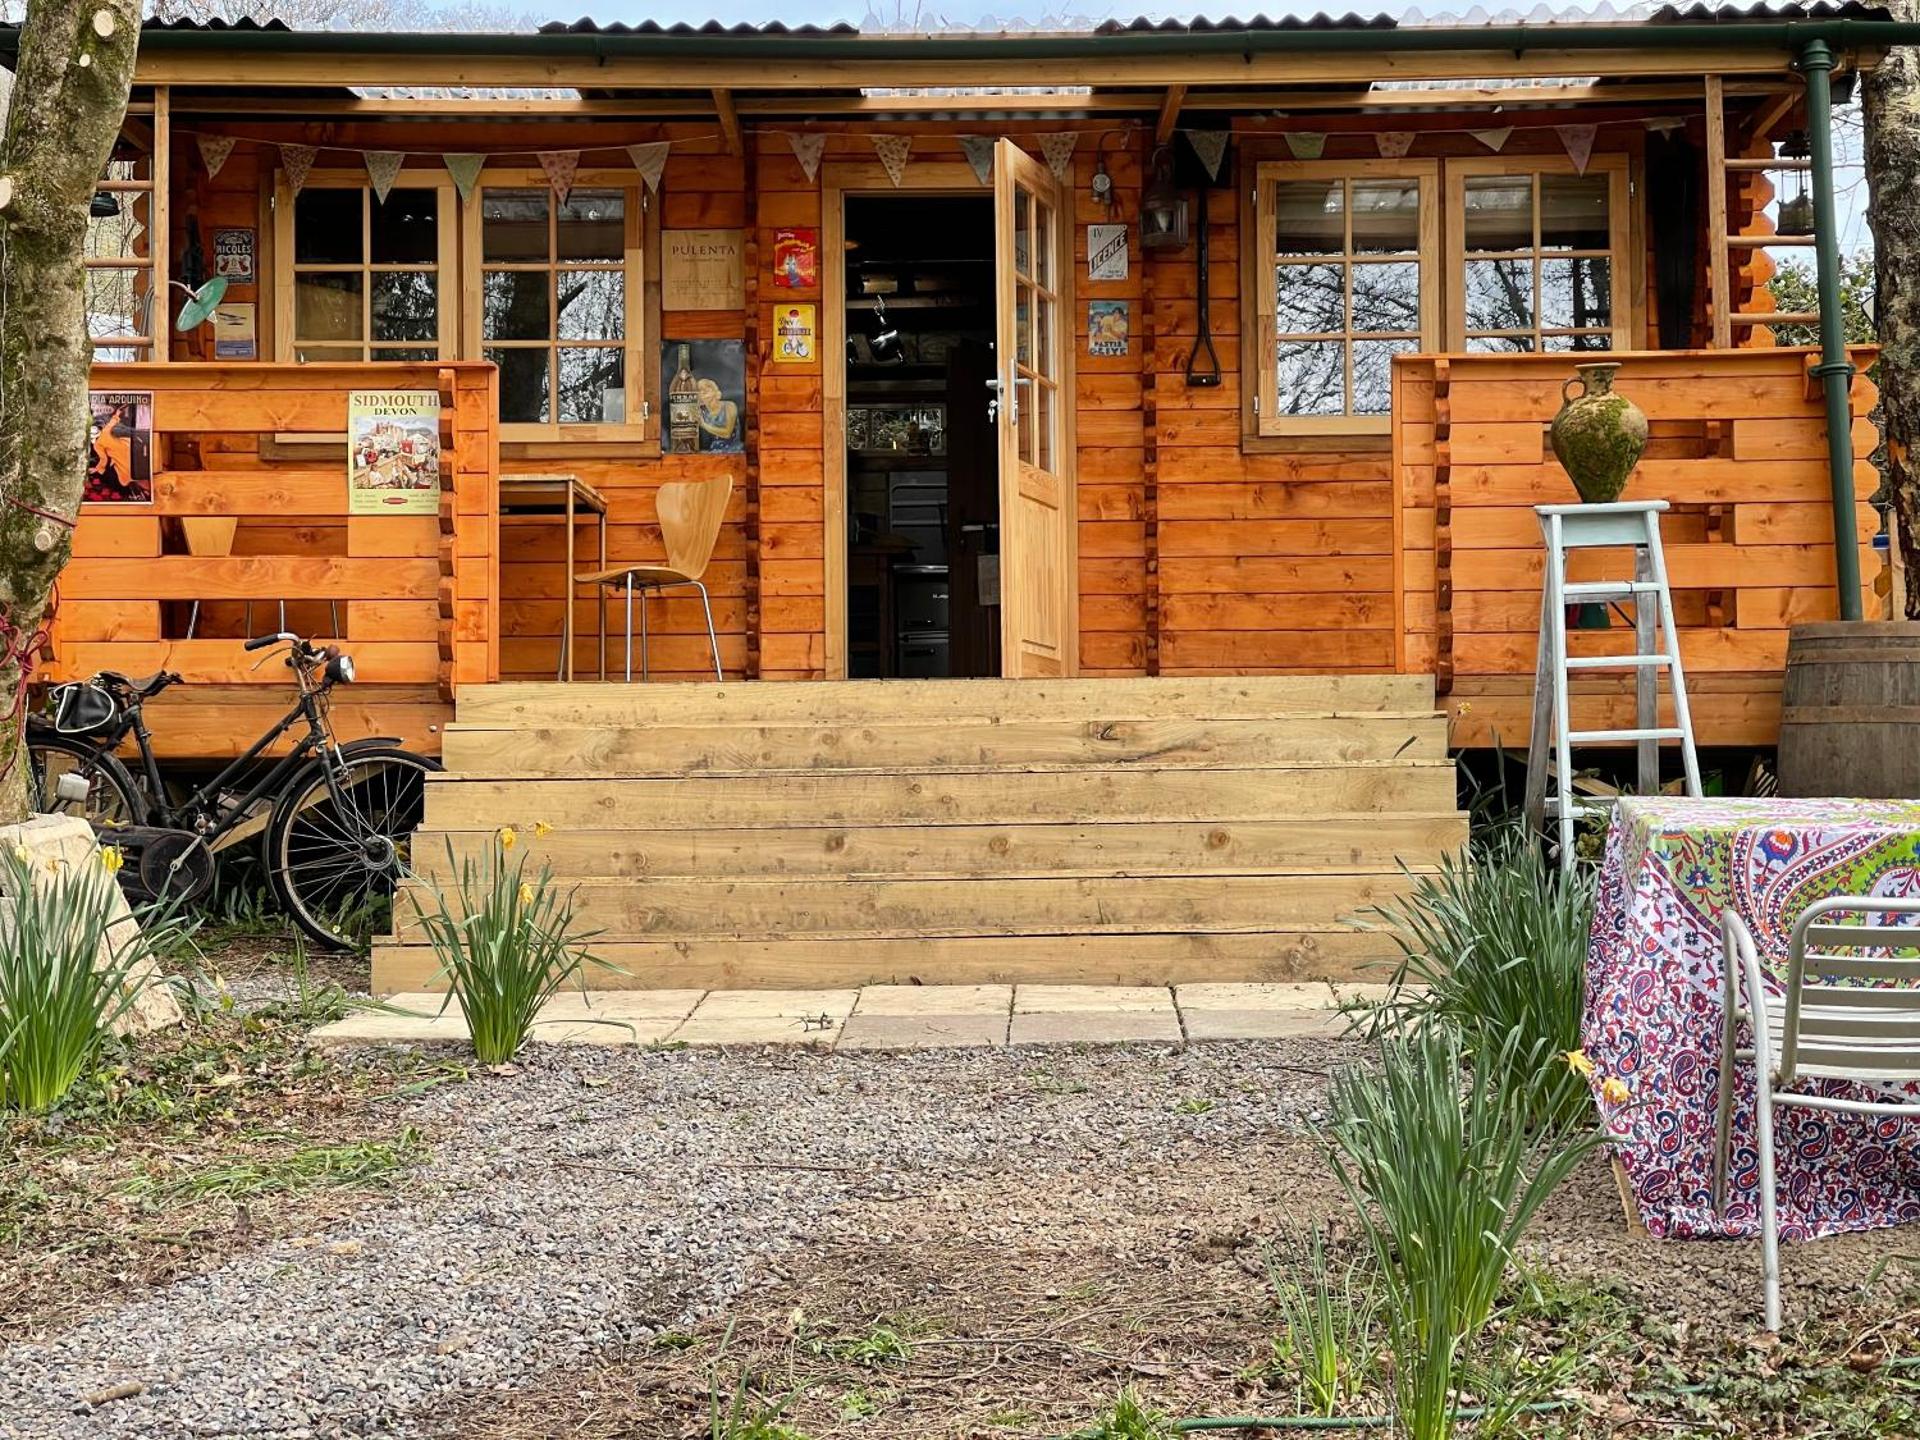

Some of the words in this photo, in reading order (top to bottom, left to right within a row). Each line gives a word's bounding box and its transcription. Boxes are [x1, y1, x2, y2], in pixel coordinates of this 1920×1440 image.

[672, 245, 736, 256] PULENTA
[354, 395, 438, 406] SIDMOUTH
[374, 407, 417, 415] DEVON
